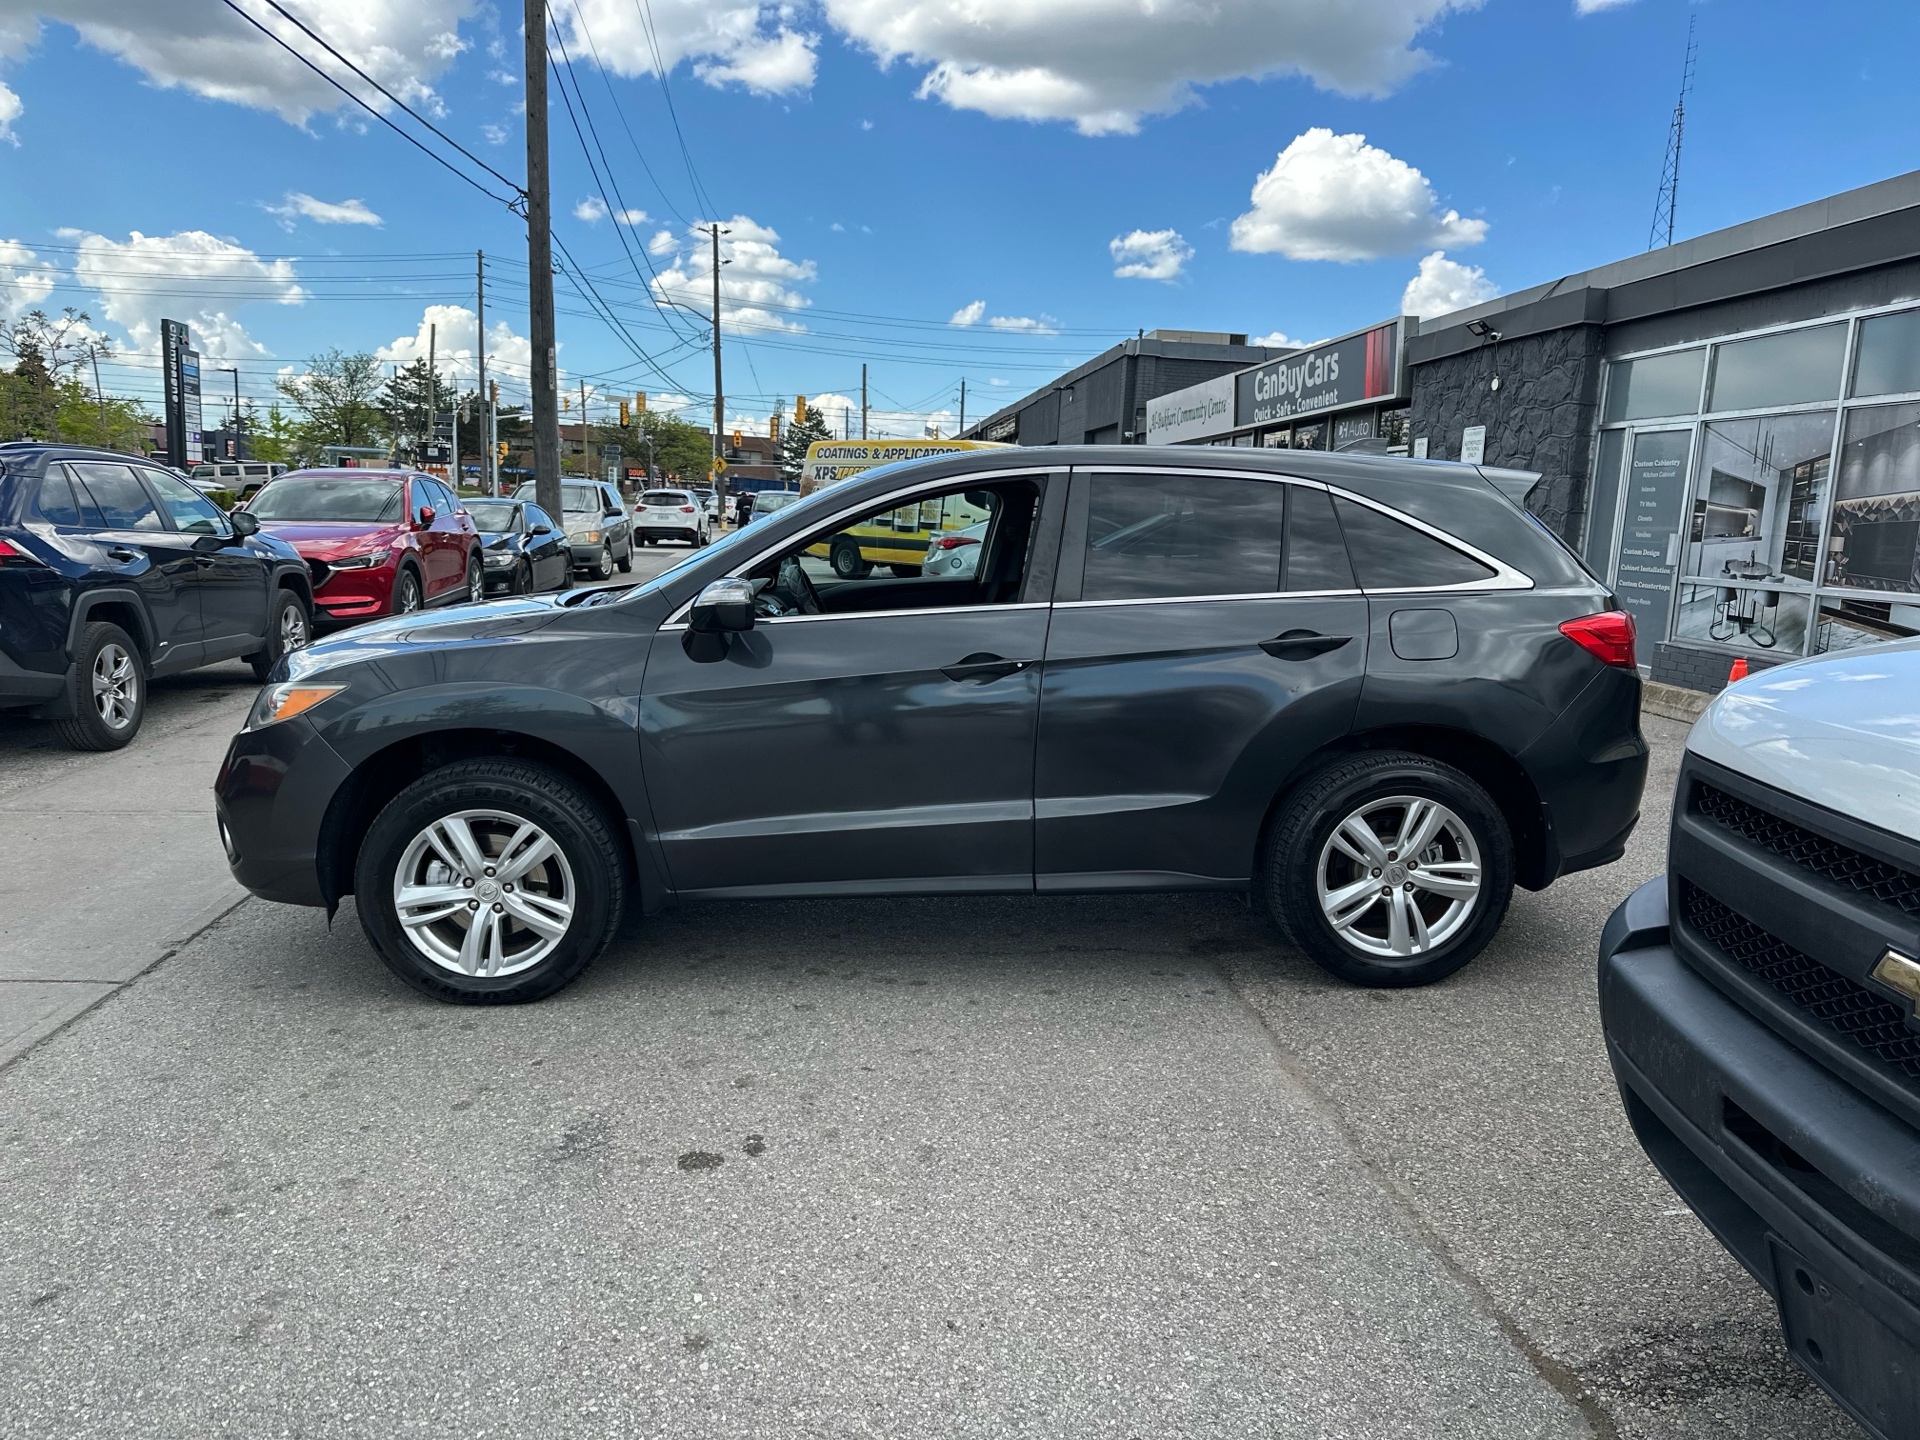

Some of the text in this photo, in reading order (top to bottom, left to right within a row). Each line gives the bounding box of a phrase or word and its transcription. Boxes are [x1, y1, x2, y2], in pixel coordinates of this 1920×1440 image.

[1254, 352, 1339, 402] CanBuyCars
[1177, 400, 1208, 426] Community
[1208, 397, 1228, 419] Centre
[1253, 405, 1272, 424] Quick
[1276, 400, 1291, 418] Safe
[1296, 388, 1338, 413] Convenient
[1348, 419, 1370, 437] Auto
[817, 447, 961, 460] COATINGS & APPLICATO
[1633, 459, 1681, 468] Custom Cabinetry
[814, 466, 871, 480] XPS XPRE
[1623, 548, 1660, 558] Custom Design
[1620, 564, 1671, 574] Cabinet Installation
[1618, 580, 1671, 592] Custom Countertops
